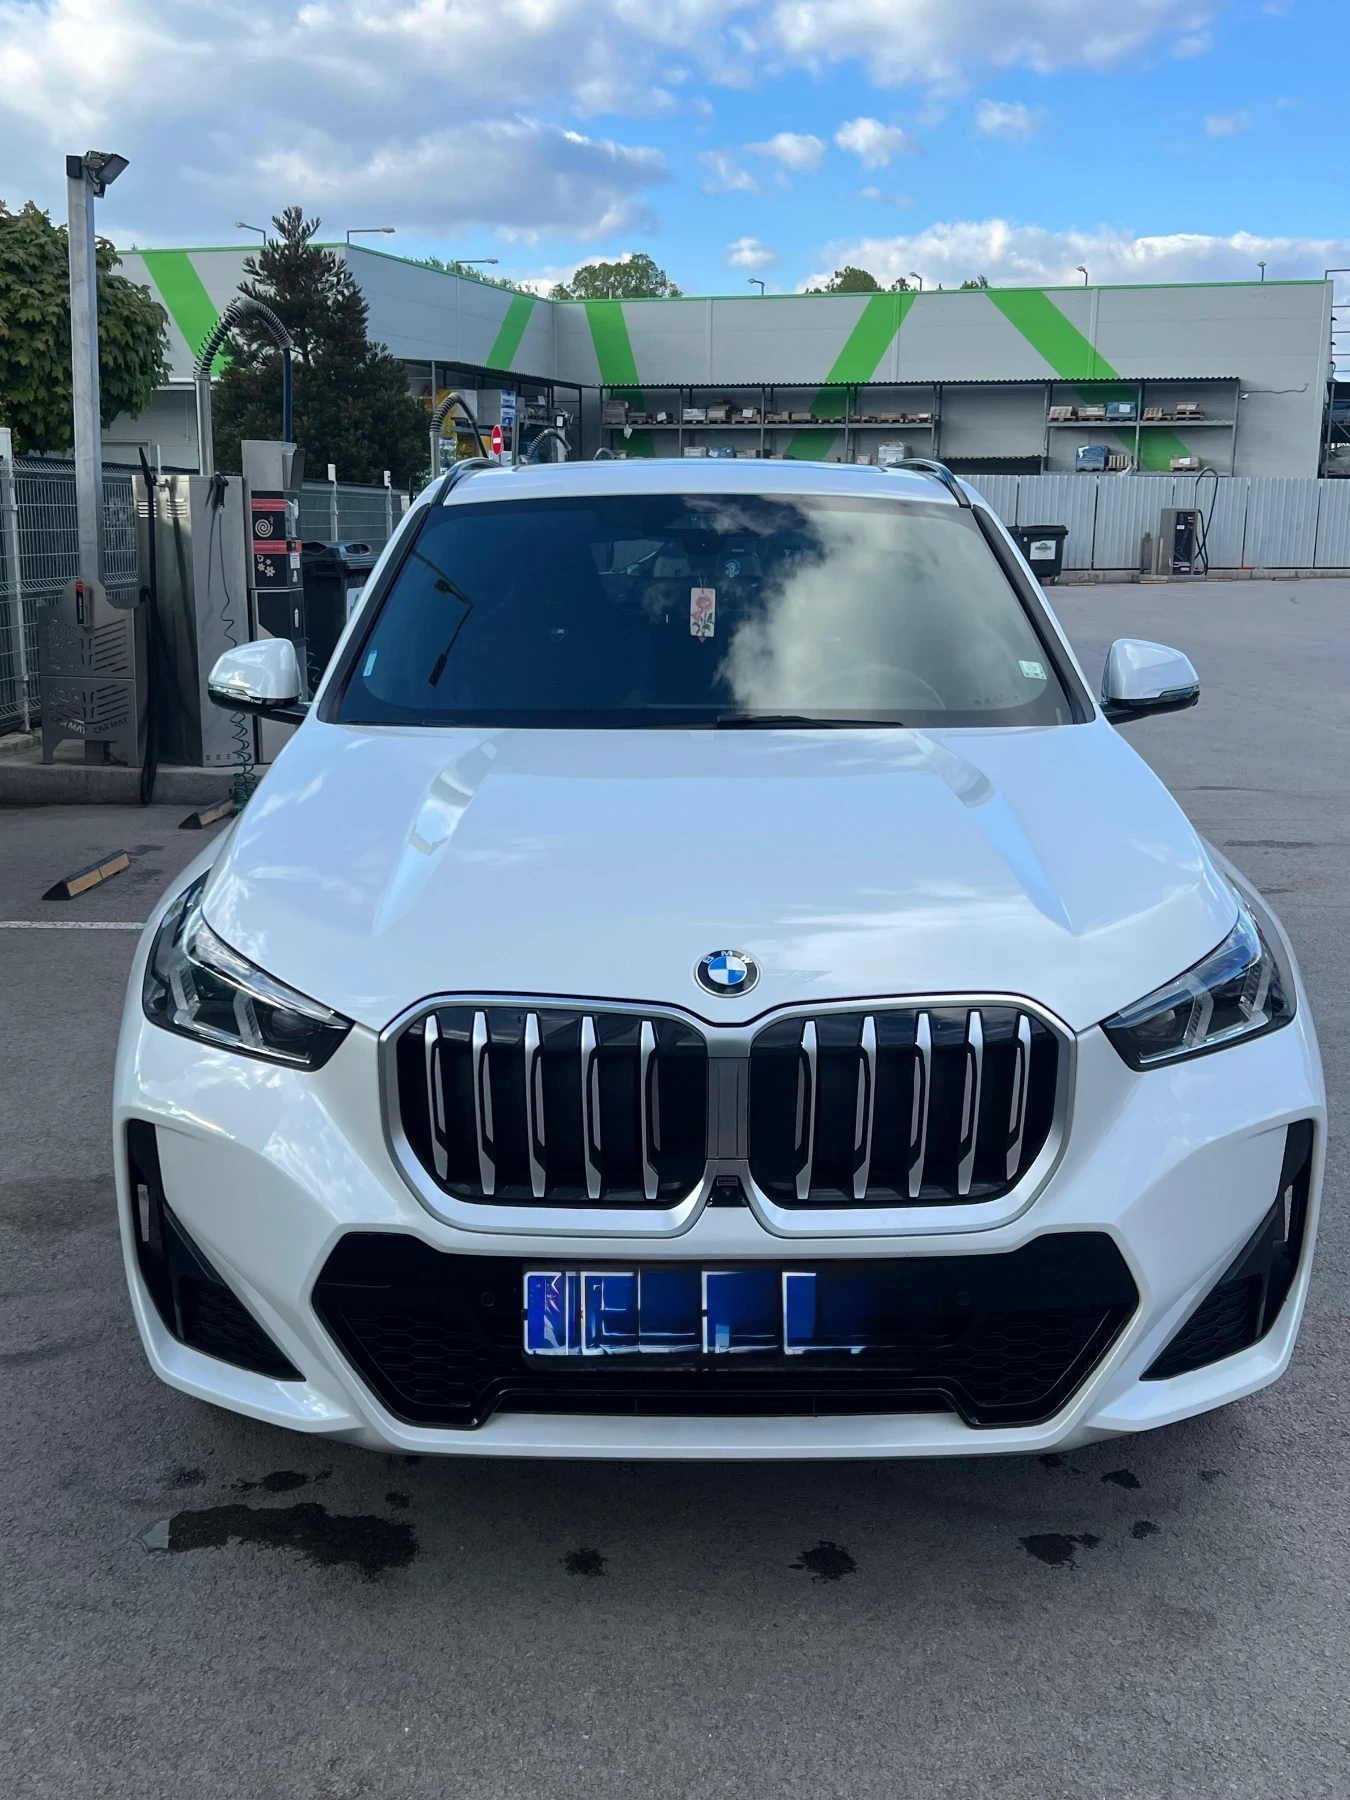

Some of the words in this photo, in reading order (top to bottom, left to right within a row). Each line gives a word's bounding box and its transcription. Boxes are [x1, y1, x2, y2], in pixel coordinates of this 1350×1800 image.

[51, 716, 68, 728] CAR
[67, 721, 87, 734] MAT
[93, 724, 110, 734] CAR
[110, 717, 128, 728] MAT
[702, 950, 753, 964] BMW
